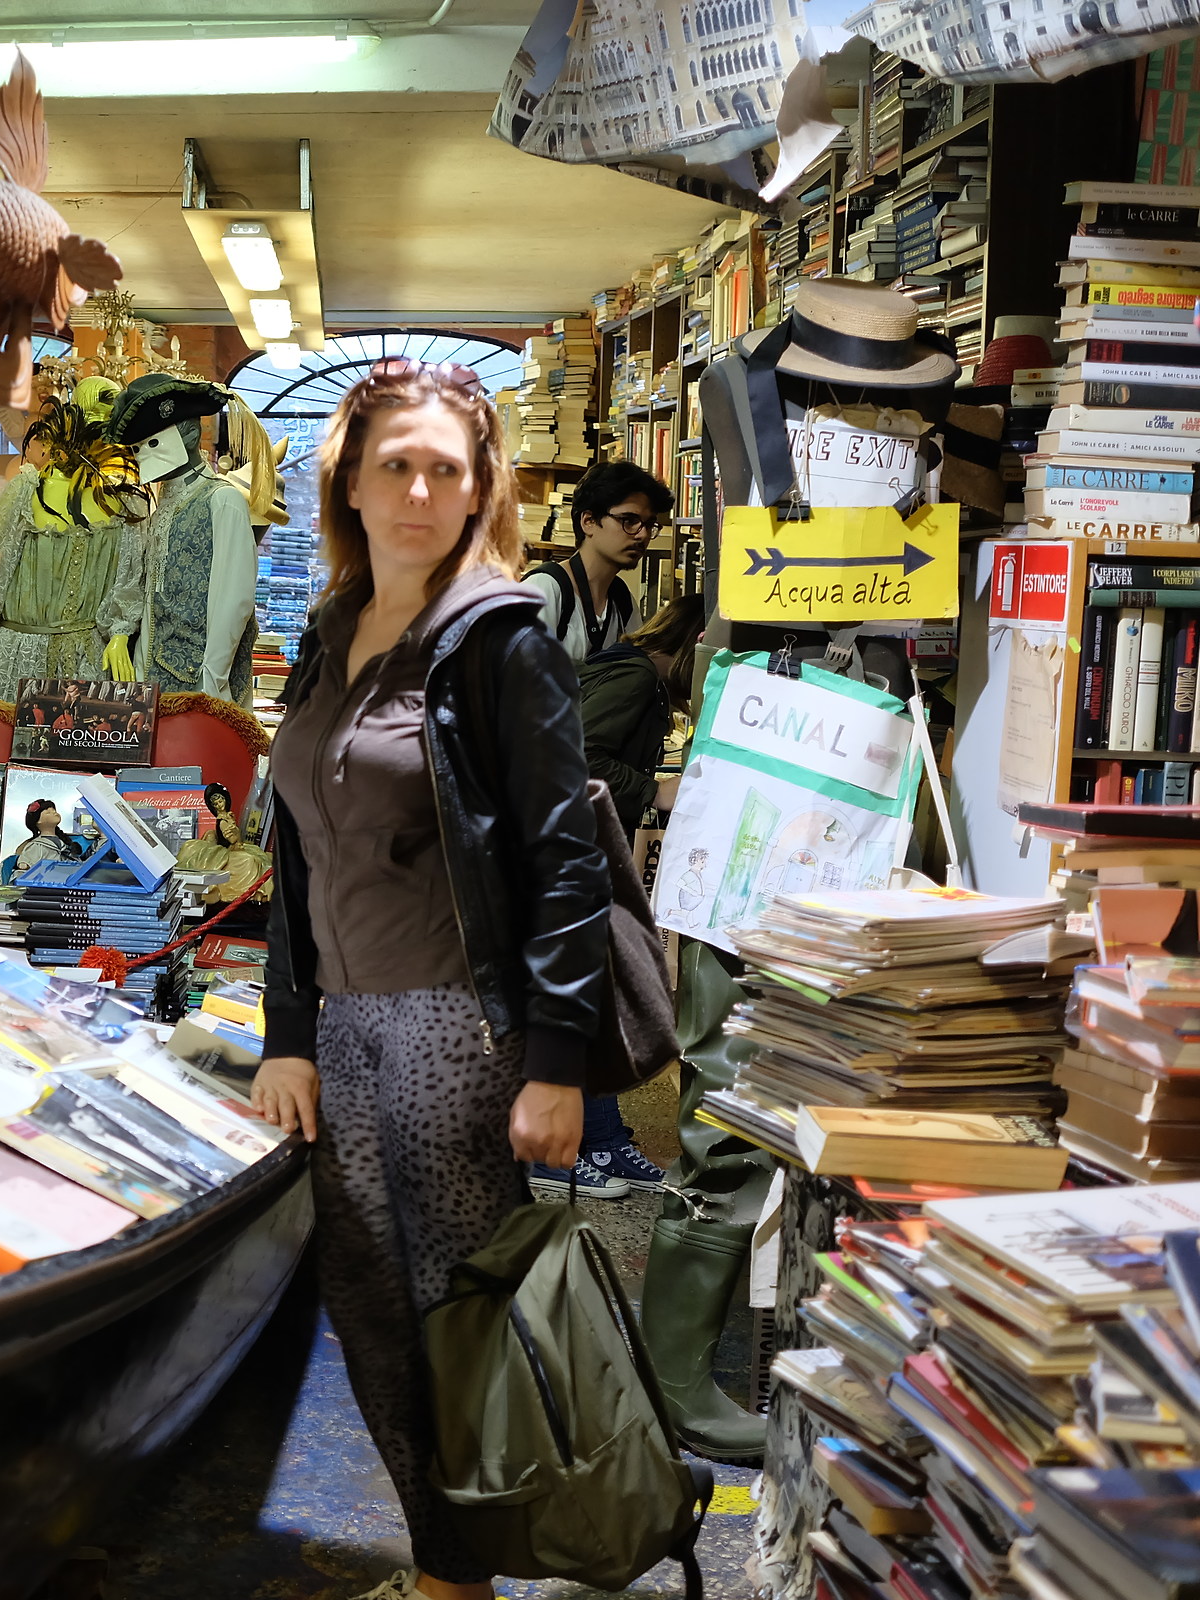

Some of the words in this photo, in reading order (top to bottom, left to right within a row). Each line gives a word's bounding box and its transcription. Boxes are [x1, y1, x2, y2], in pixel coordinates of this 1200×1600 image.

[1118, 287, 1155, 306] segreto
[1145, 420, 1152, 428] LE
[786, 427, 835, 461] IRE
[845, 434, 915, 470] EXIT
[1071, 440, 1088, 448] JOHN
[1153, 445, 1186, 453] ASSOLUTI
[1080, 497, 1120, 506] L'ONOREVOLE
[1080, 504, 1106, 512] SCOLARO
[1067, 521, 1080, 530] LE
[1110, 542, 1122, 553] 12
[1099, 567, 1133, 577] JEFFERY
[1156, 569, 1172, 578] CORPI
[1023, 572, 1066, 594] ESTINTORE
[1163, 577, 1194, 586] INDIETRO
[764, 577, 844, 614] Acqua
[852, 572, 912, 605] alta
[1090, 666, 1104, 720] CONTINUUM
[1122, 666, 1134, 709] GHIACCIO
[1174, 666, 1197, 712] MIKO
[738, 694, 848, 759] CANAL
[1120, 712, 1130, 734] DURO
[60, 728, 140, 744] GONDOLA
[74, 740, 101, 748] SECOLI
[159, 773, 192, 782] Cantiere
